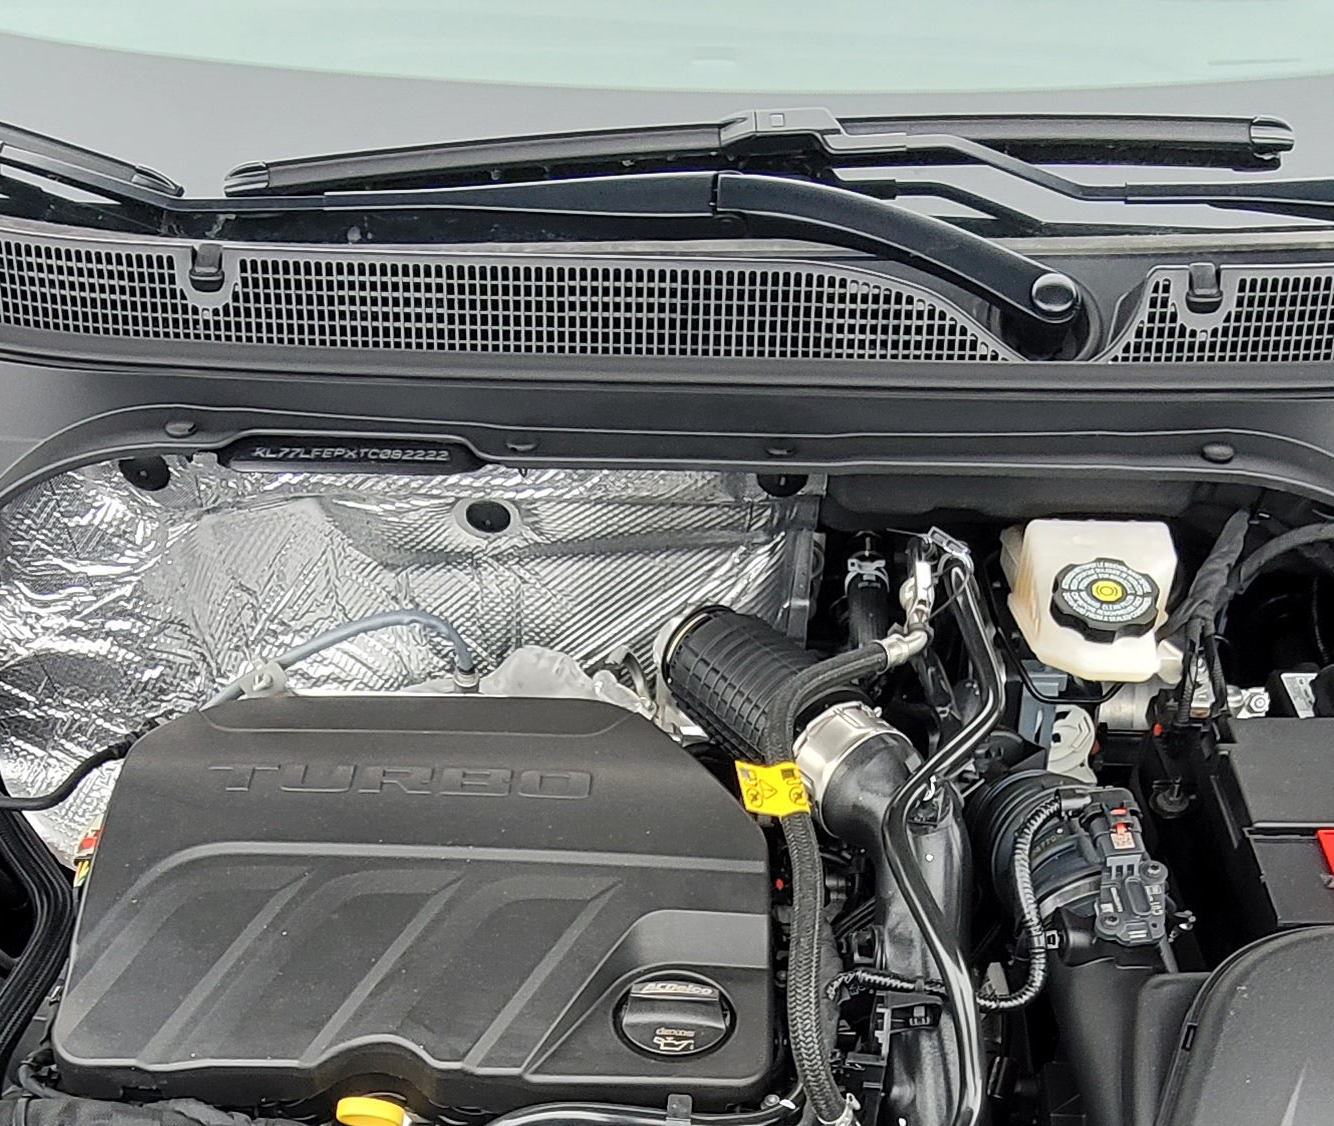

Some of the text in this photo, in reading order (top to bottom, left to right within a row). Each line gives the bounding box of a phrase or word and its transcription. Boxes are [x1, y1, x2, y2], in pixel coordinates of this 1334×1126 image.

[252, 446, 450, 461] KL77LFEPXTC082222
[208, 763, 594, 800] TURBO
[641, 983, 713, 995] ACDelco
